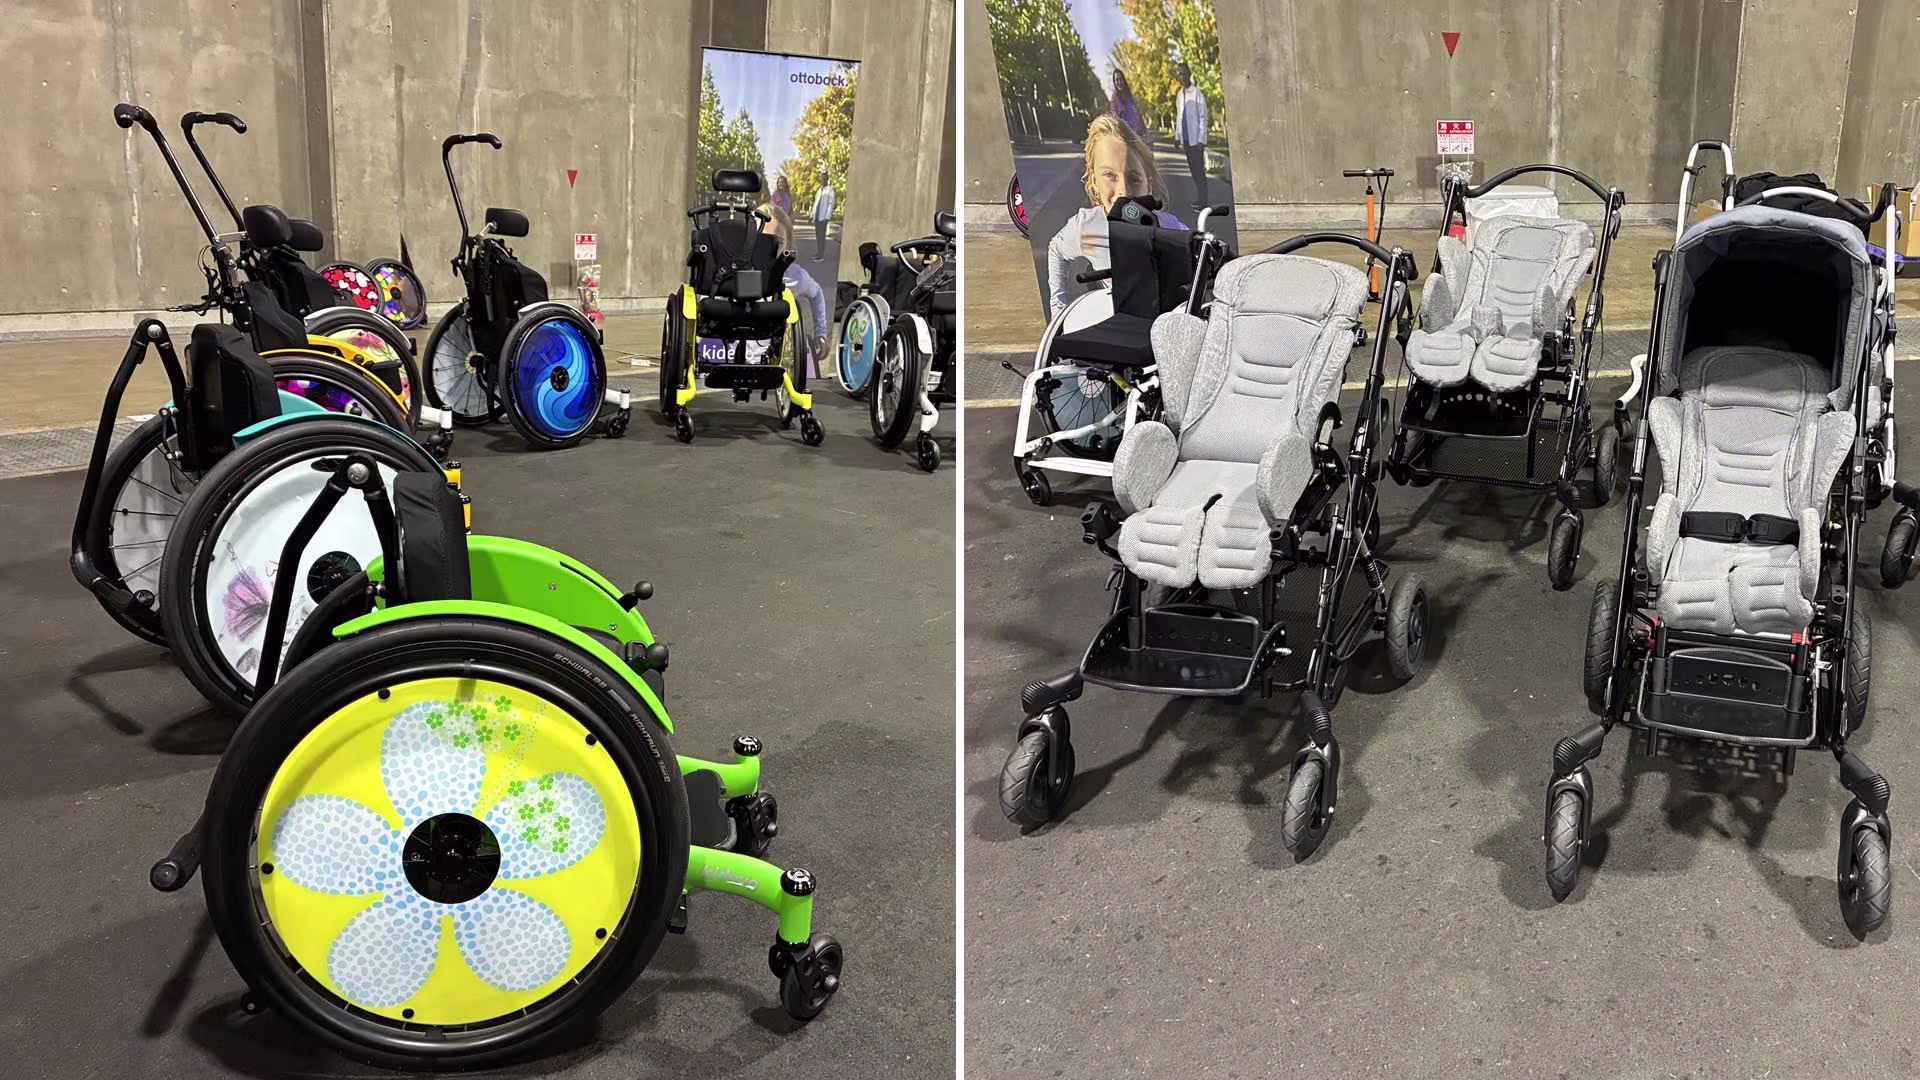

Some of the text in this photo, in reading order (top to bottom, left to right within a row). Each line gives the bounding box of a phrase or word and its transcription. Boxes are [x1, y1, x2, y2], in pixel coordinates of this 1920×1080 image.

[790, 72, 849, 87] ottobock.
[702, 344, 754, 360] kideo
[553, 652, 608, 689] SCHWALBE
